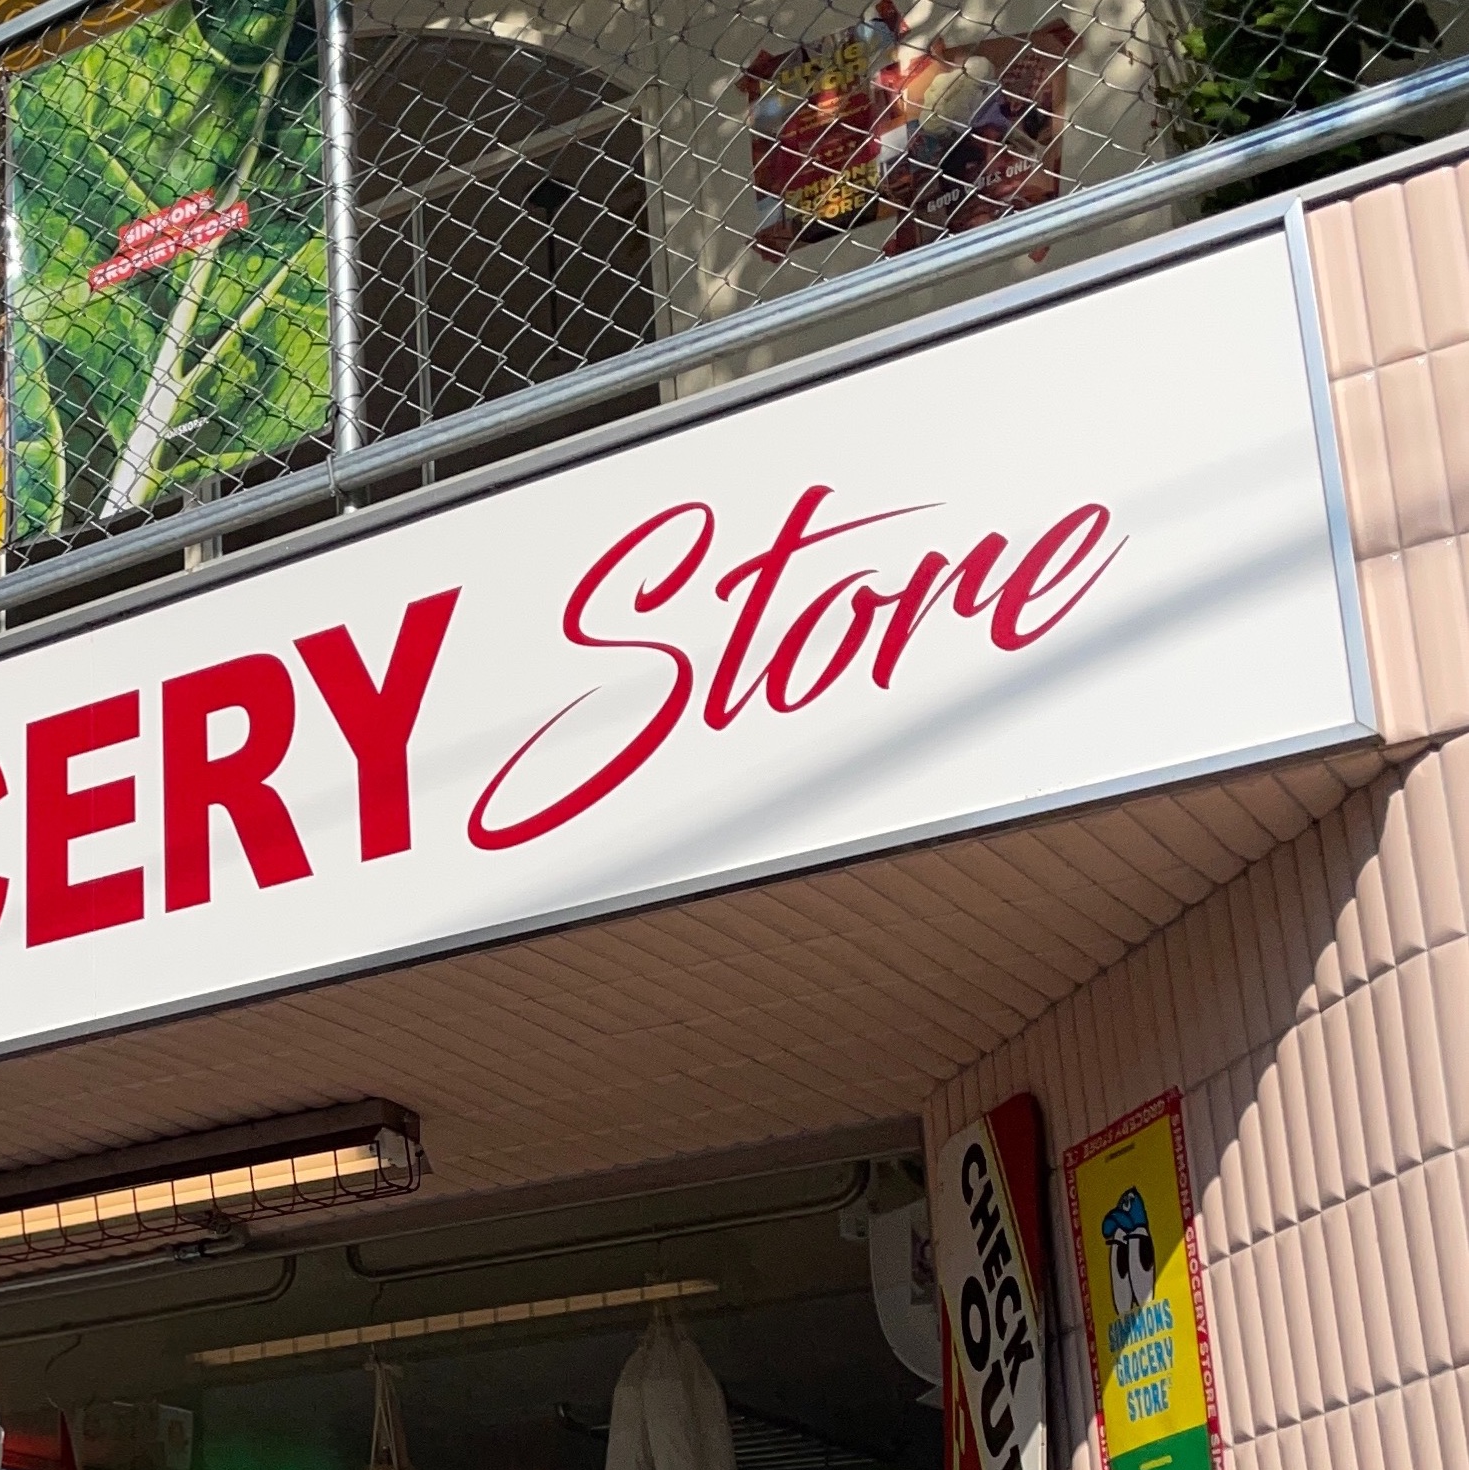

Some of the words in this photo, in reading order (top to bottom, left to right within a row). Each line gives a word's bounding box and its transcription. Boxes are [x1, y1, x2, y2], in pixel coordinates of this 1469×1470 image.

[468, 485, 1130, 851] Store
[961, 1142, 1035, 1398] CHECK
[1107, 1298, 1175, 1353] SIMMONS
[1184, 1226, 1208, 1333] GROCERY
[1198, 1341, 1218, 1419] STORE
[1116, 1336, 1175, 1388] GROCERY
[1126, 1378, 1170, 1422] STORE
